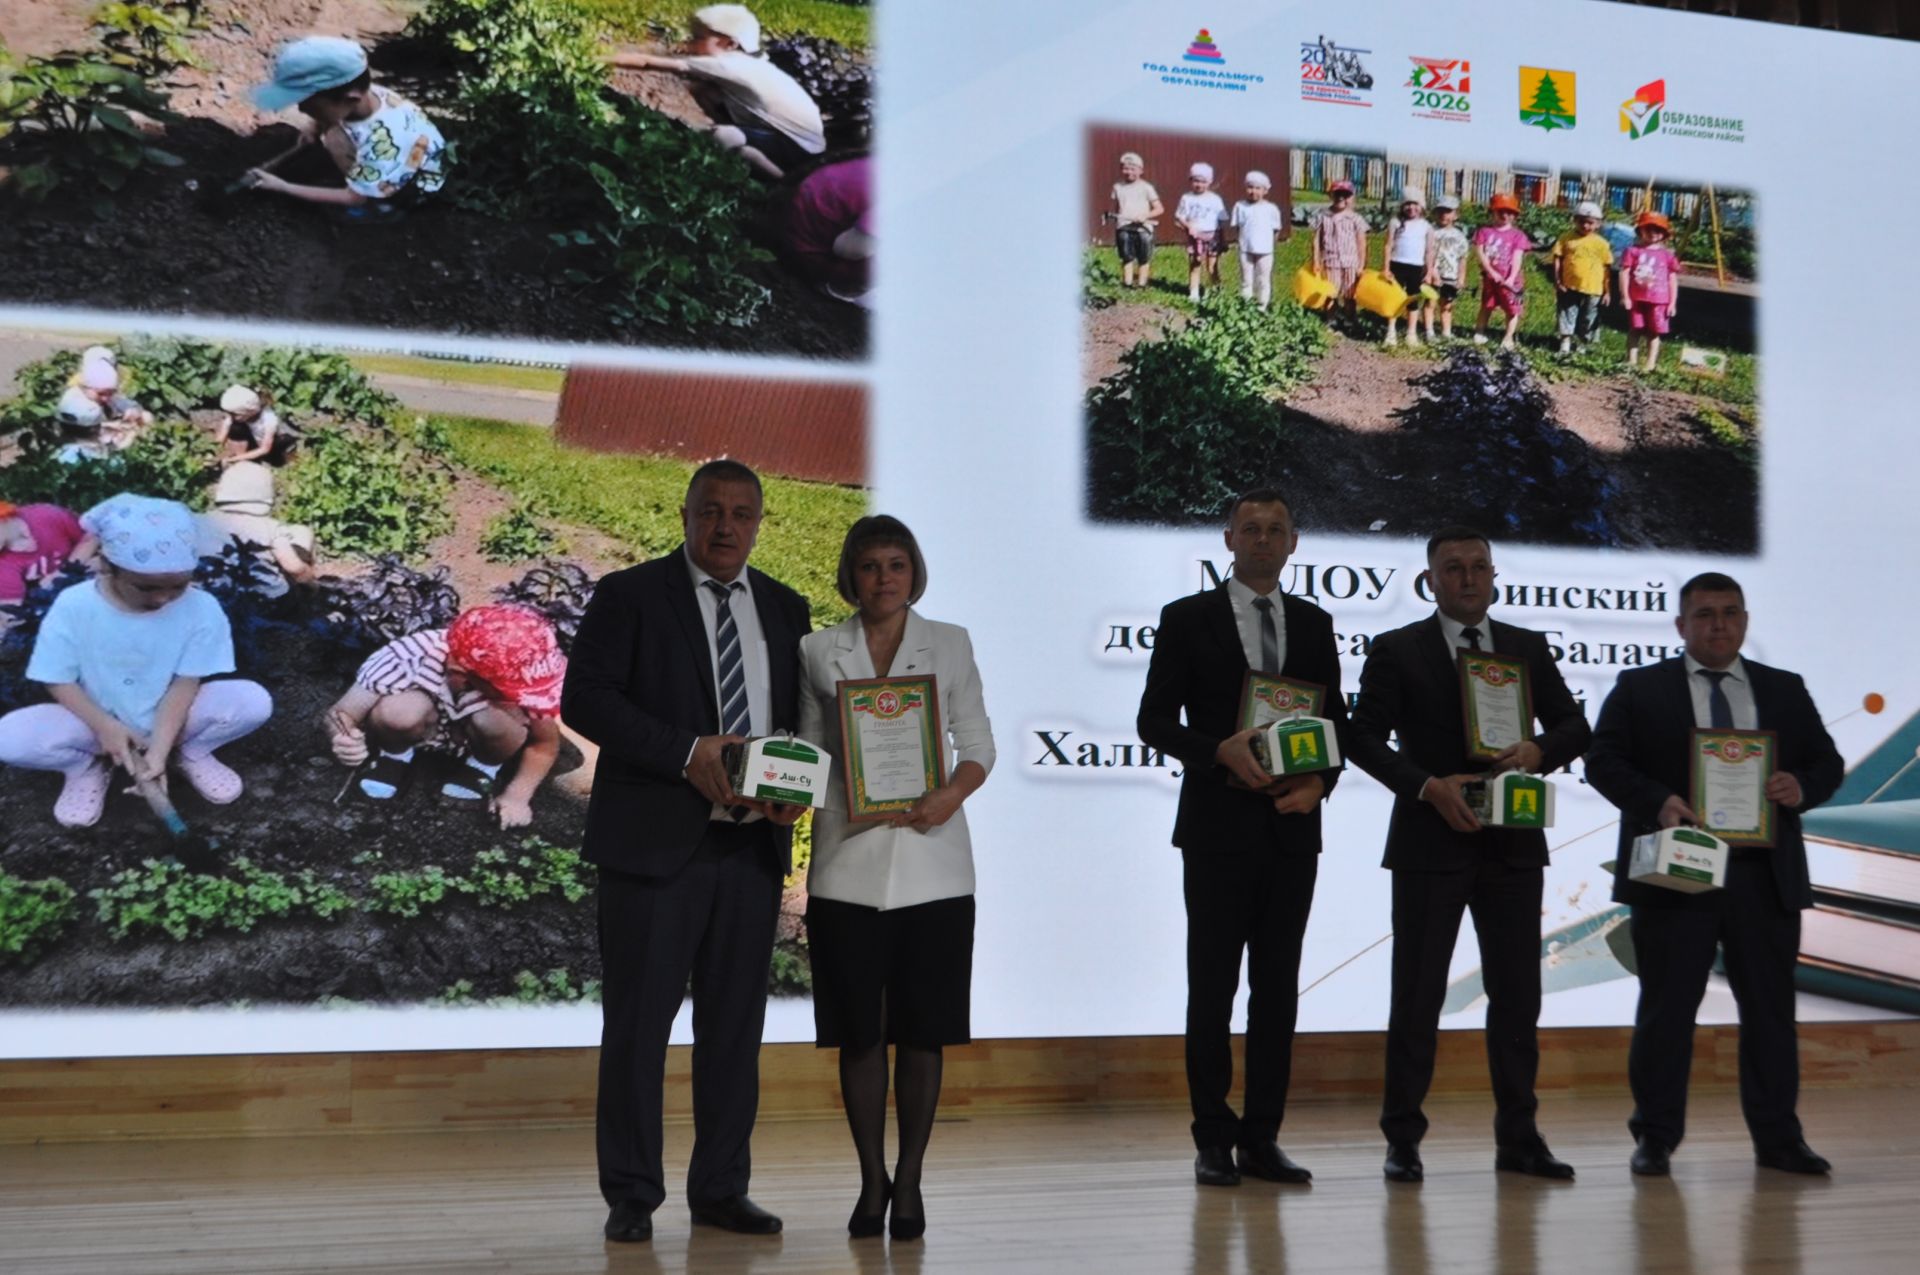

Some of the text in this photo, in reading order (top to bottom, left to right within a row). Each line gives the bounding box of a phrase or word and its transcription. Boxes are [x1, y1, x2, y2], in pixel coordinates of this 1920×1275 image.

[1143, 62, 1264, 83] ГОД ДОШКОЛЬНОГО
[1301, 64, 1325, 81] 26
[1161, 75, 1247, 92] ОБРАЗОВАНИЯ
[1411, 90, 1470, 112] 2026
[1663, 111, 1744, 132] ОБРАЗОВАНИЕ
[1196, 559, 1397, 603] МДОУ
